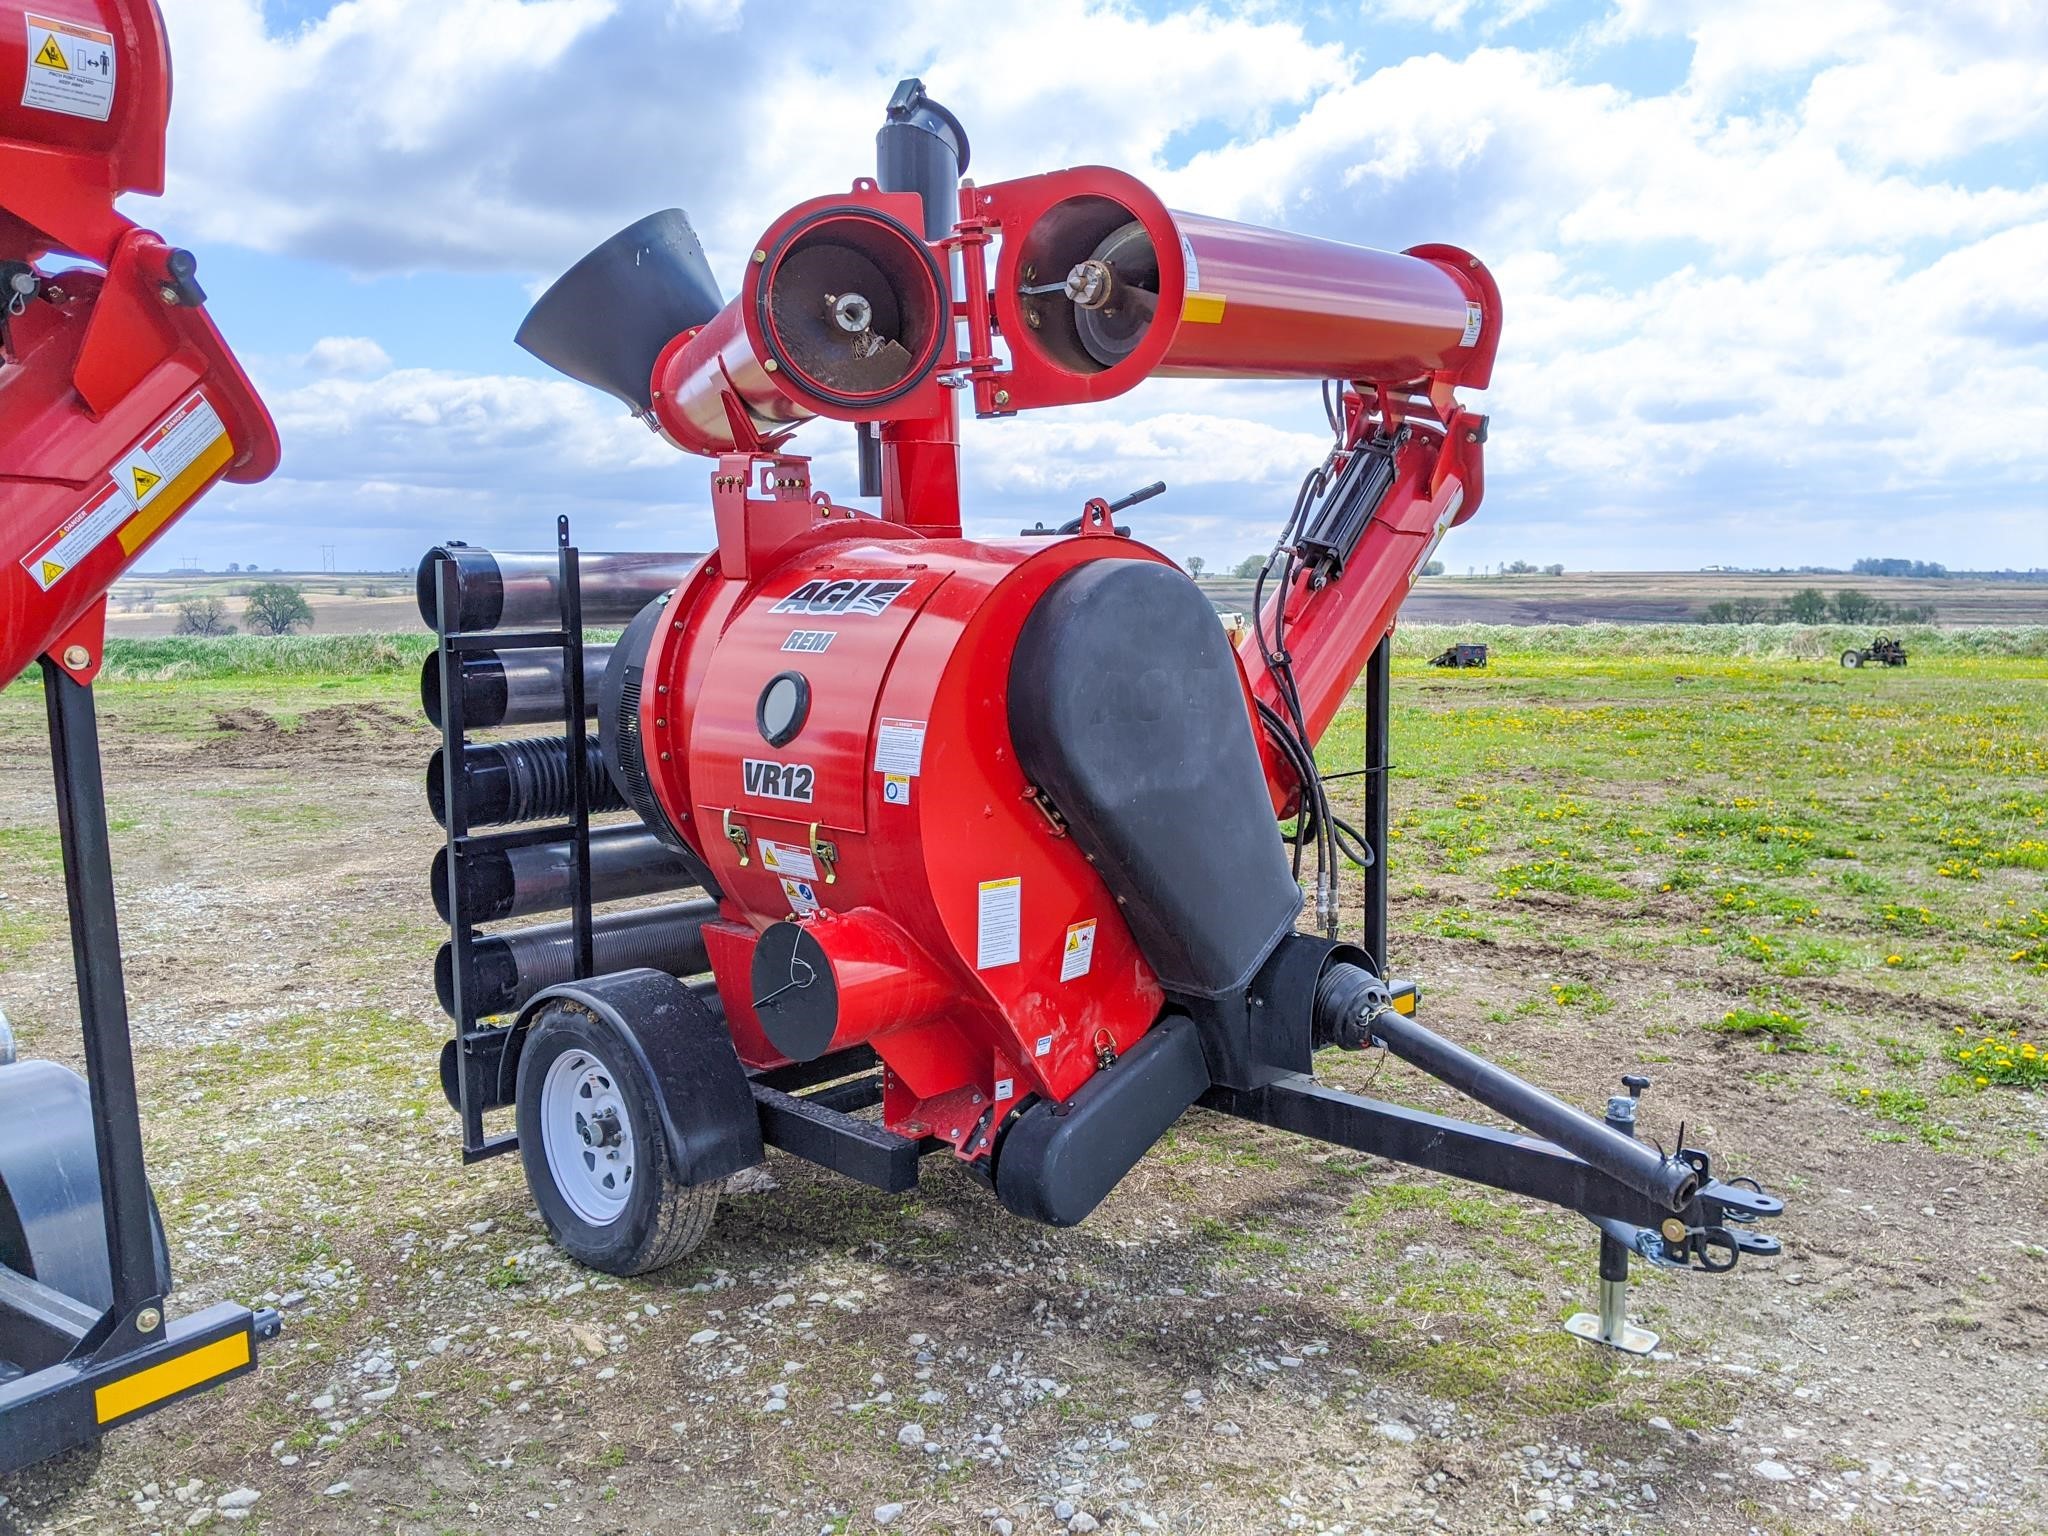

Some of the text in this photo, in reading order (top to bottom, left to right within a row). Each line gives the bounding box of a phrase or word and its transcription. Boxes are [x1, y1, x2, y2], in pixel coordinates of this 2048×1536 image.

[166, 409, 187, 431] DANGER
[64, 510, 88, 533] DANGER
[772, 580, 870, 612] AGI
[783, 630, 835, 652] REM
[745, 762, 813, 800] VR12
